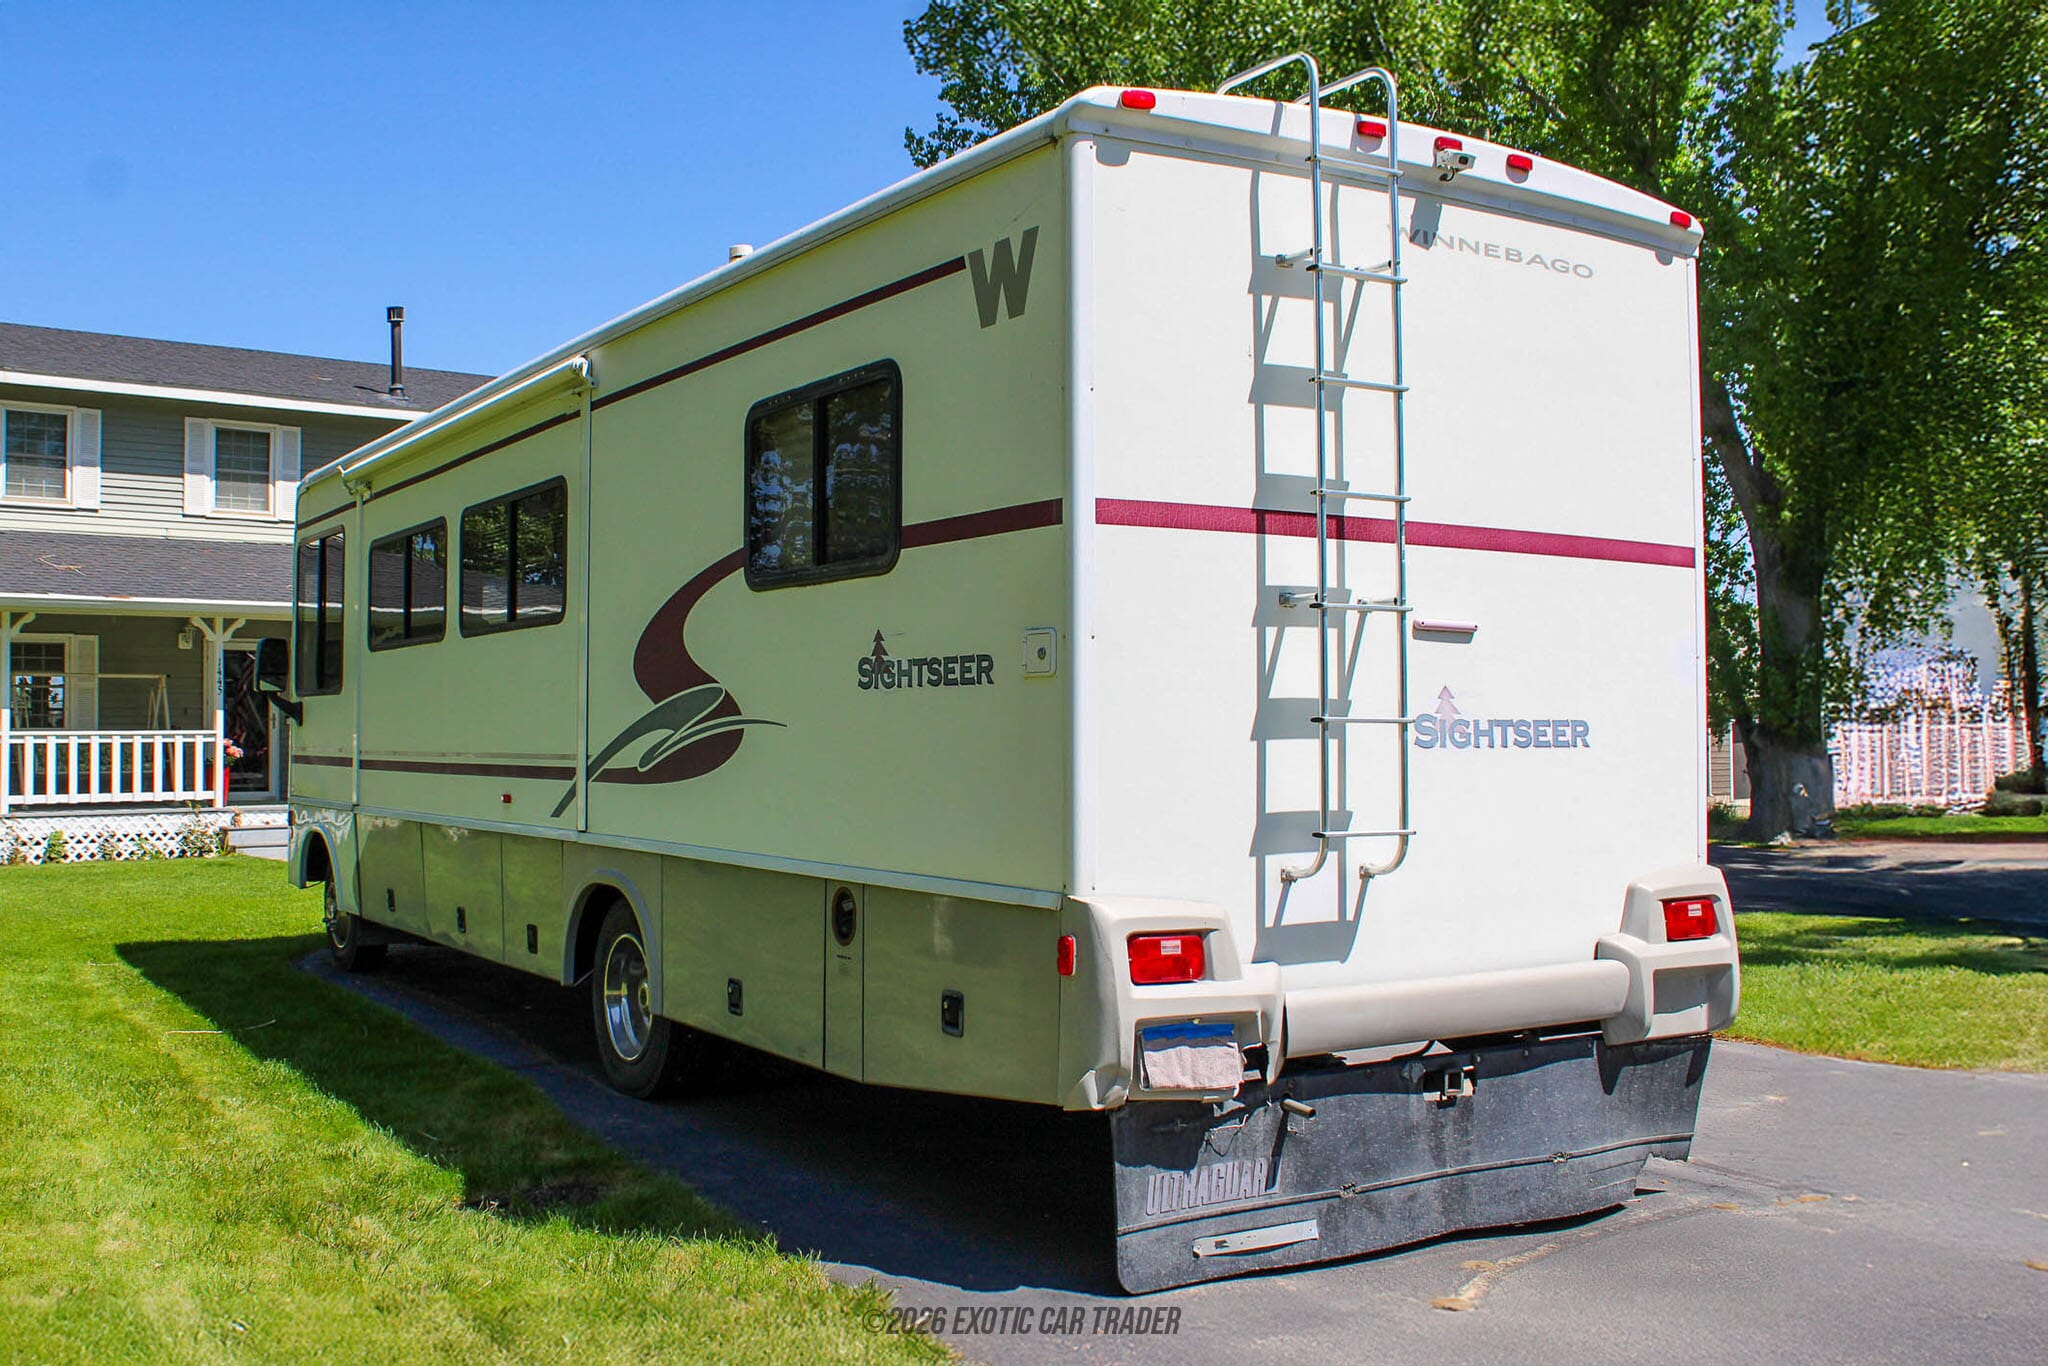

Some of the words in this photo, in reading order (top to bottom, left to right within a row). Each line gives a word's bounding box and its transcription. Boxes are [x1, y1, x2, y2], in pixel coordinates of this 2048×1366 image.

[1387, 224, 1594, 280] WINNEBAGO
[967, 224, 1040, 329] W
[857, 654, 995, 690] SIGHTSEER
[1414, 713, 1591, 749] SIGHTSEER
